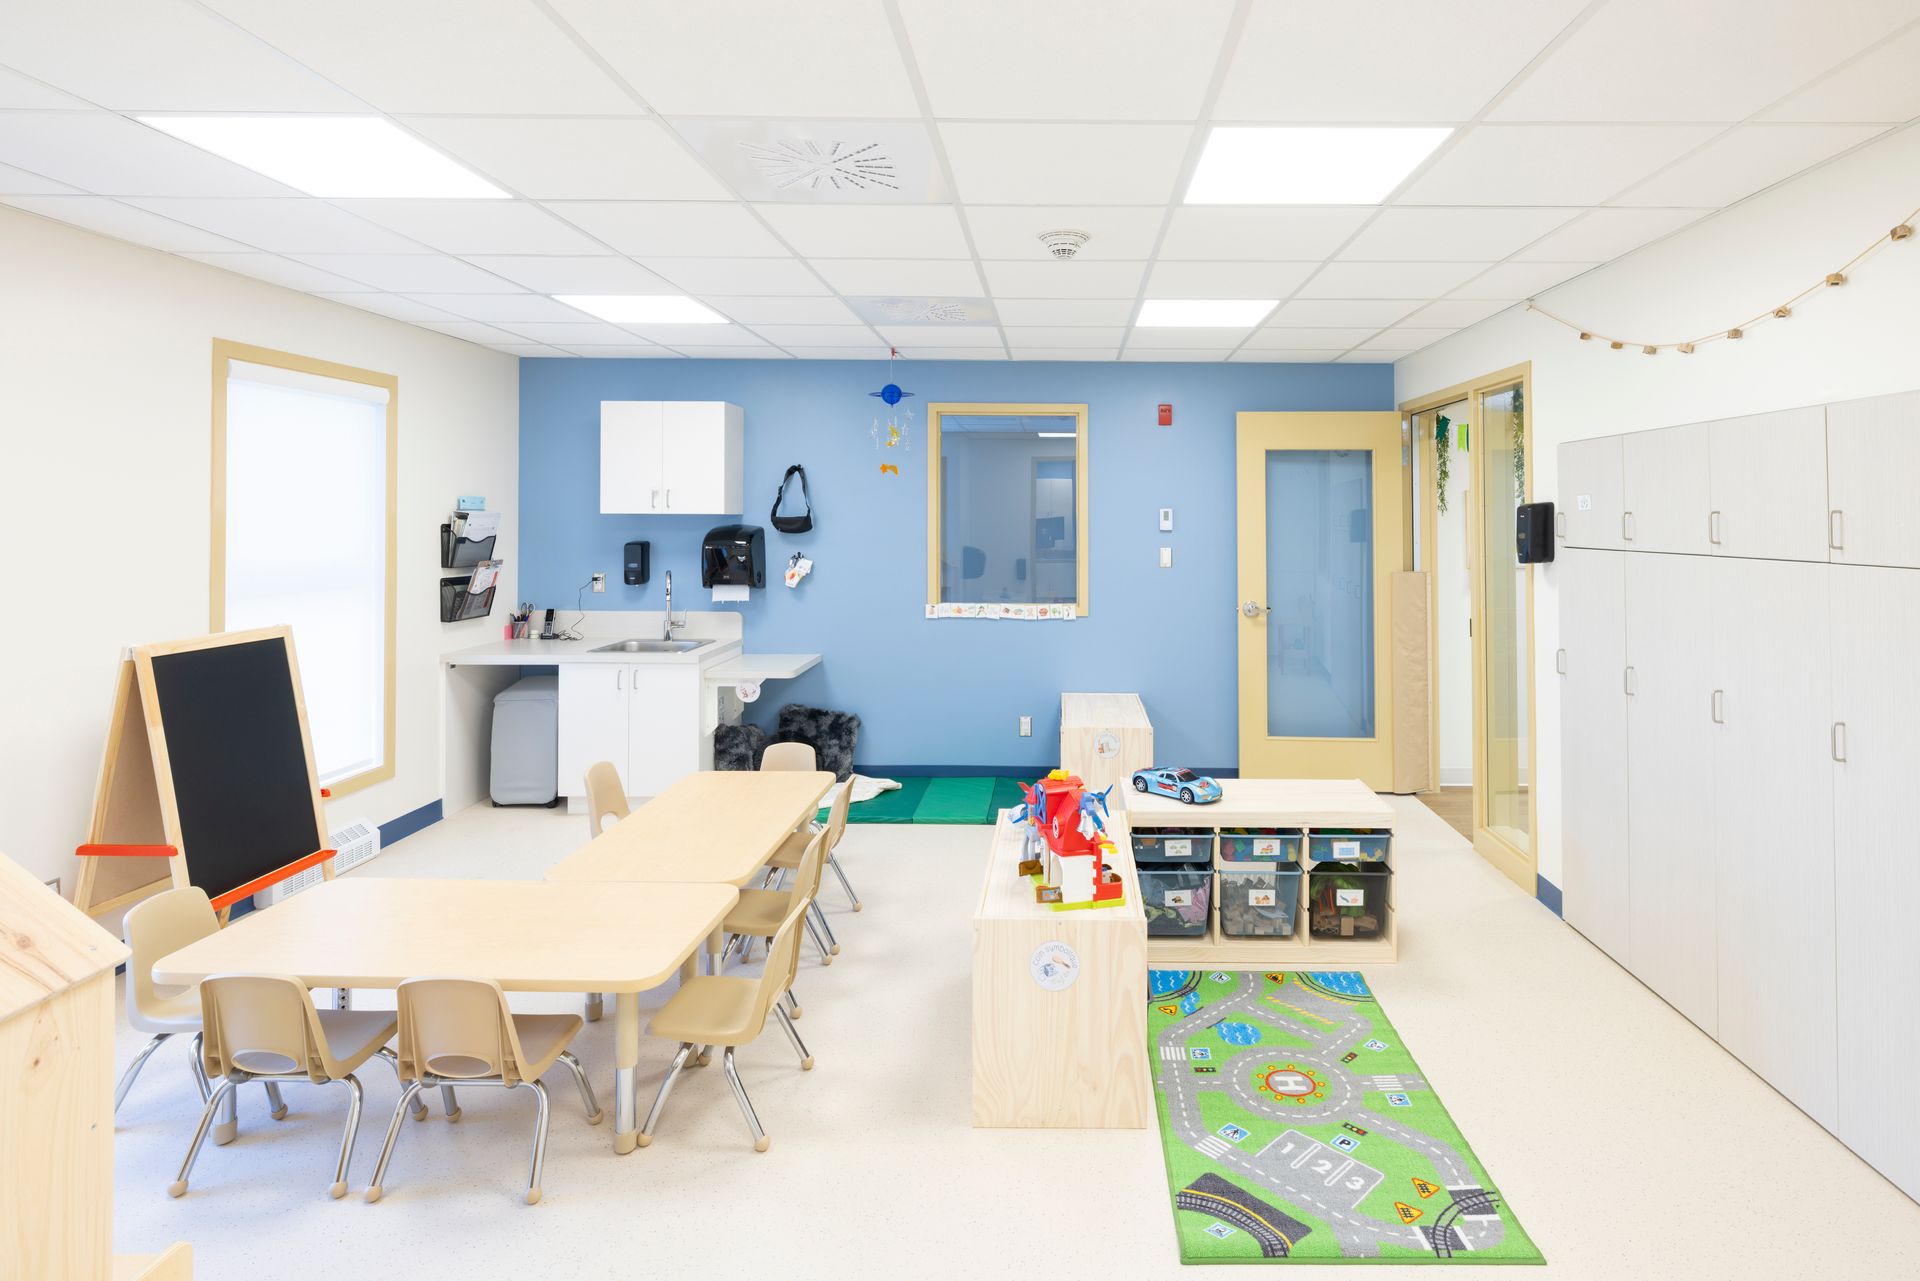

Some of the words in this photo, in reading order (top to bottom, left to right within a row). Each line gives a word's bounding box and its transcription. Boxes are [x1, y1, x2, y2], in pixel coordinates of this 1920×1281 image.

[1274, 1076, 1308, 1091] H
[1280, 1142, 1295, 1154] 1
[1311, 1160, 1332, 1174] 2
[1345, 1176, 1365, 1190] 3
